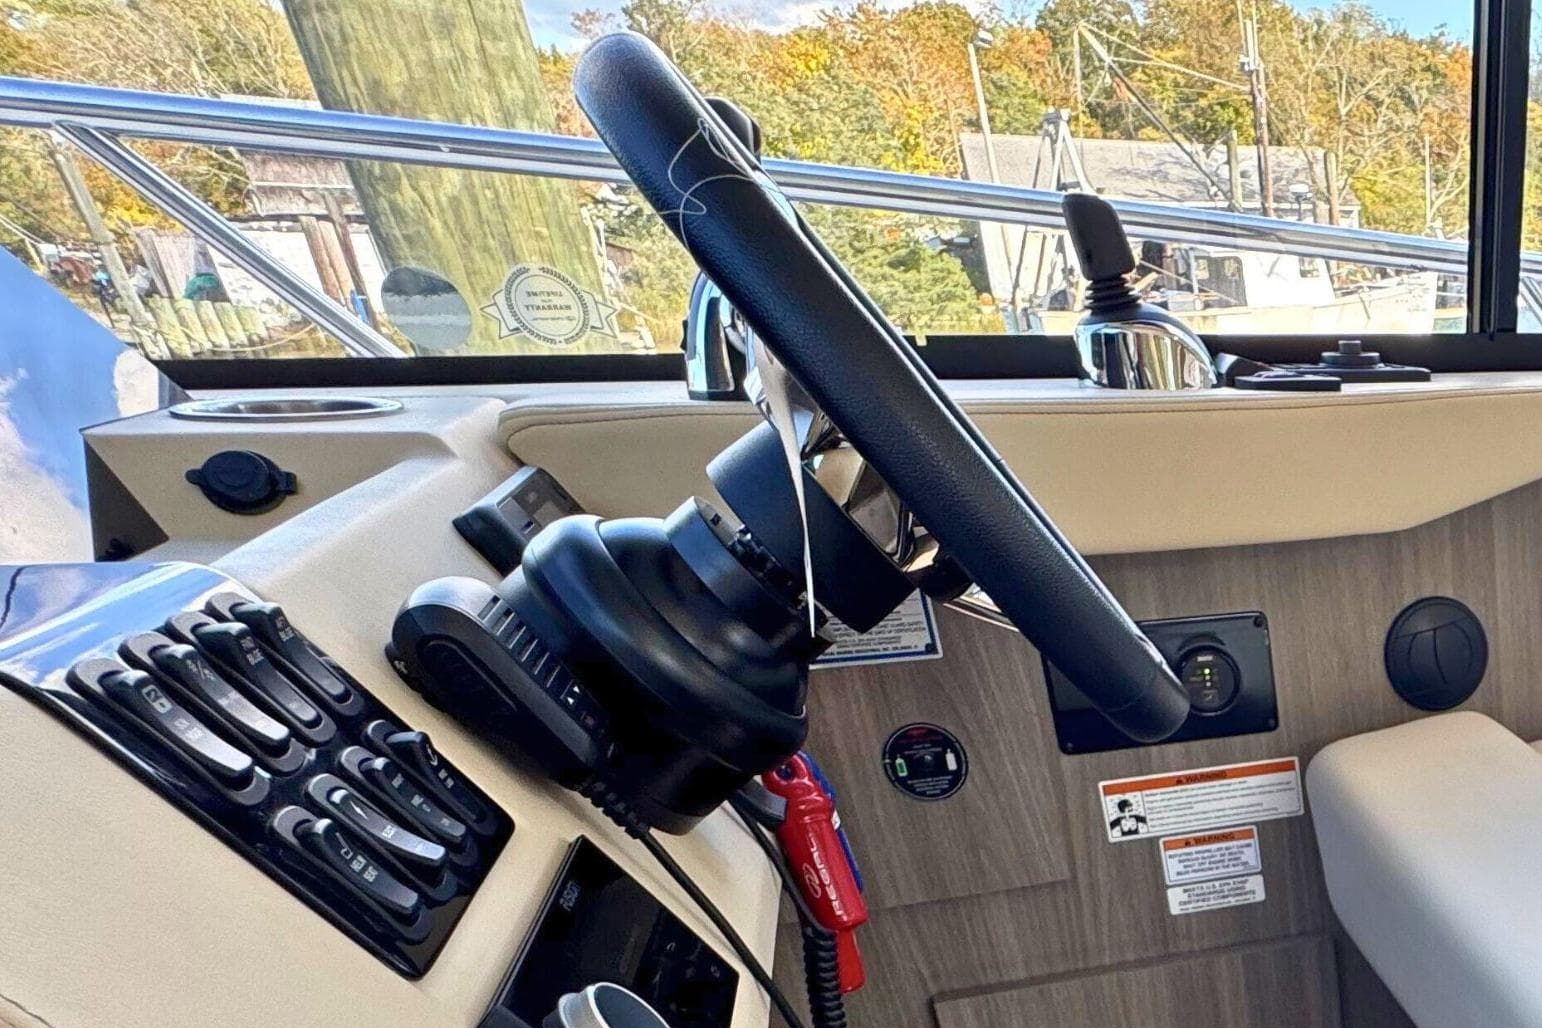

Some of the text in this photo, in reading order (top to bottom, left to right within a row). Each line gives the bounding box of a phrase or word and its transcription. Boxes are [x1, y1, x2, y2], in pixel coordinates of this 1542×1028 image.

[1184, 770, 1227, 784] WARNING
[1193, 831, 1235, 844] WARNING
[809, 834, 844, 917] REGAL
